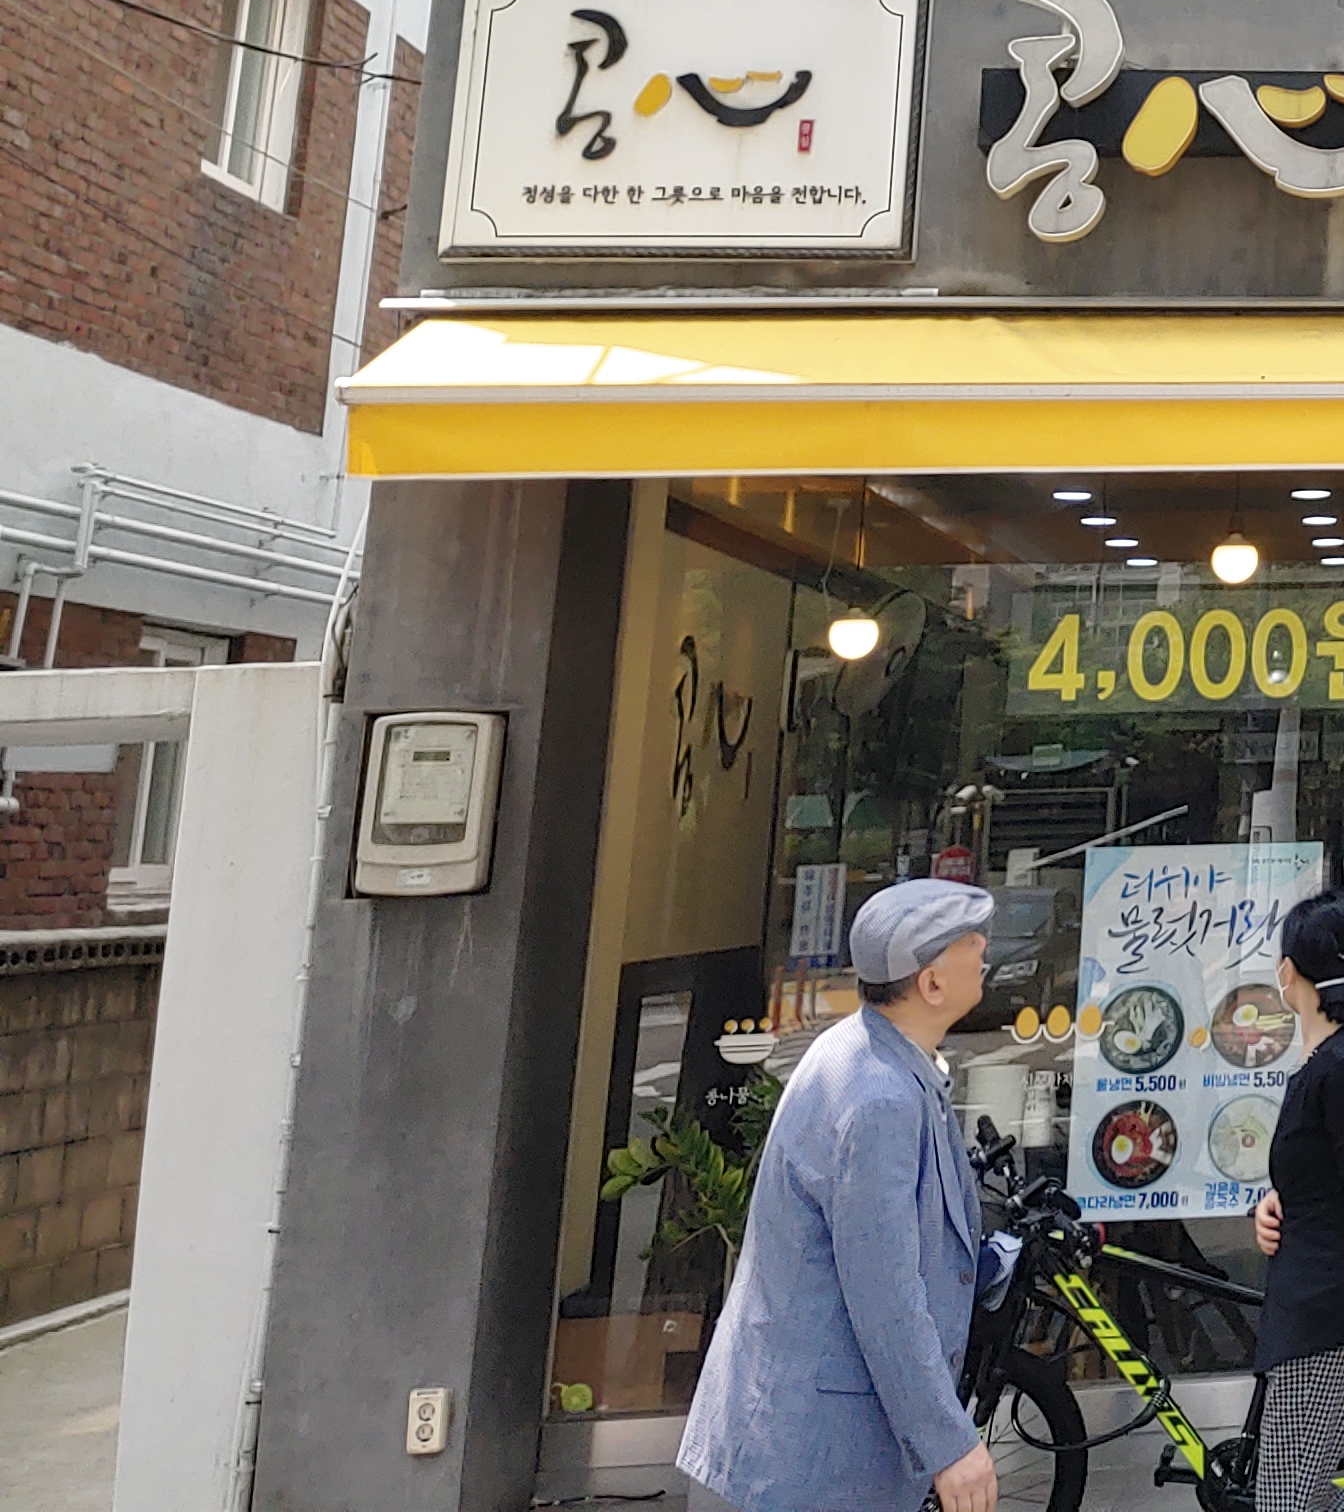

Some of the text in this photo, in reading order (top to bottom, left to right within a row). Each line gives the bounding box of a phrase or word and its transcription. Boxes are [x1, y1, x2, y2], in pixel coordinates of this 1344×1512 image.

[522, 184, 576, 205] 정성을
[582, 184, 620, 205] 다한
[626, 184, 645, 205] 한
[651, 185, 725, 206] 그릇으로
[730, 184, 786, 206] 마음을
[1120, 863, 1232, 903] 더위야
